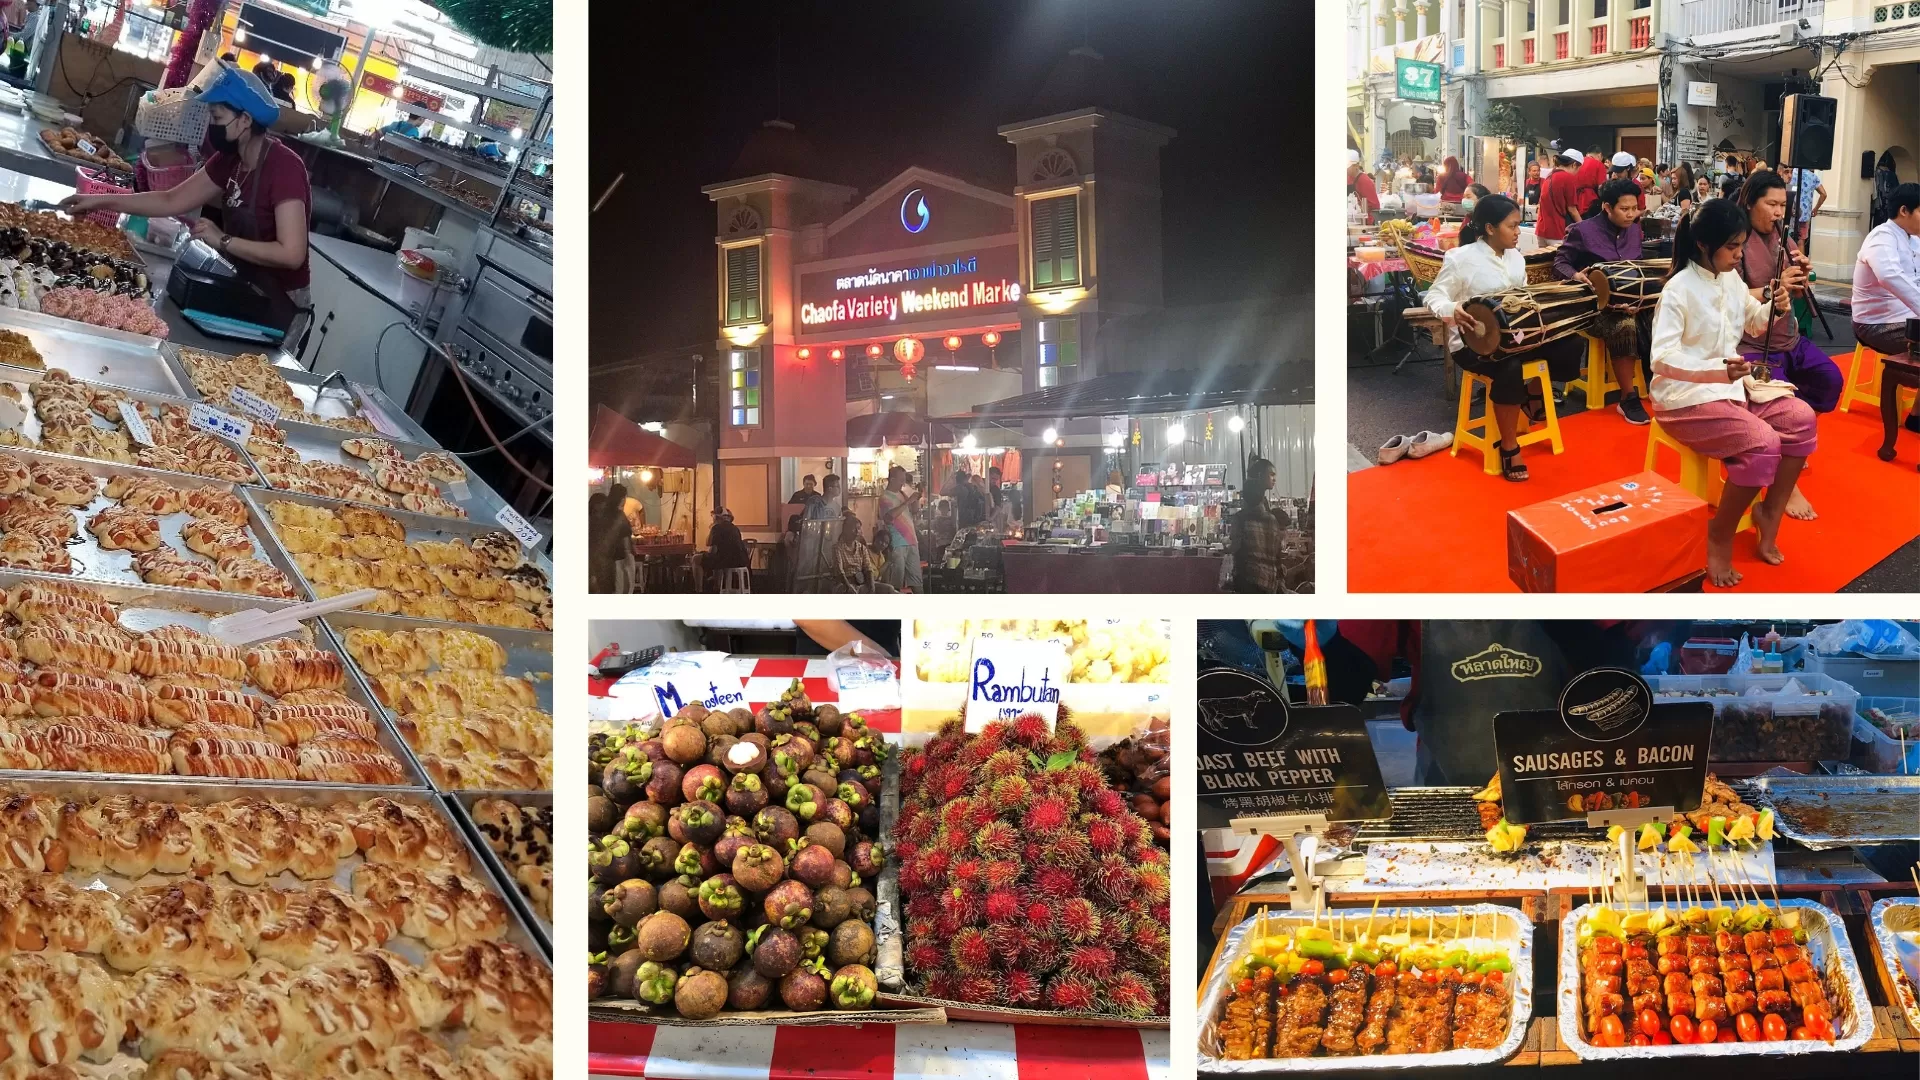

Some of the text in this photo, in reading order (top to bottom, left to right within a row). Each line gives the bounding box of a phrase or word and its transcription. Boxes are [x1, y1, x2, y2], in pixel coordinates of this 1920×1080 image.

[801, 279, 1021, 324] Chaofa Variety Weekend Marke
[945, 642, 960, 651] 50
[972, 657, 1060, 704] Rambutan
[653, 681, 743, 719] Mosteen
[1243, 750, 1287, 768] BEEF
[1295, 747, 1341, 765] WITH
[1513, 744, 1695, 773] SAUSAGES & BACON
[1202, 767, 1336, 790] BLACK PEPPER
[1605, 777, 1615, 787] &
[1222, 791, 1335, 809] 烤黑胡椒牛小排
